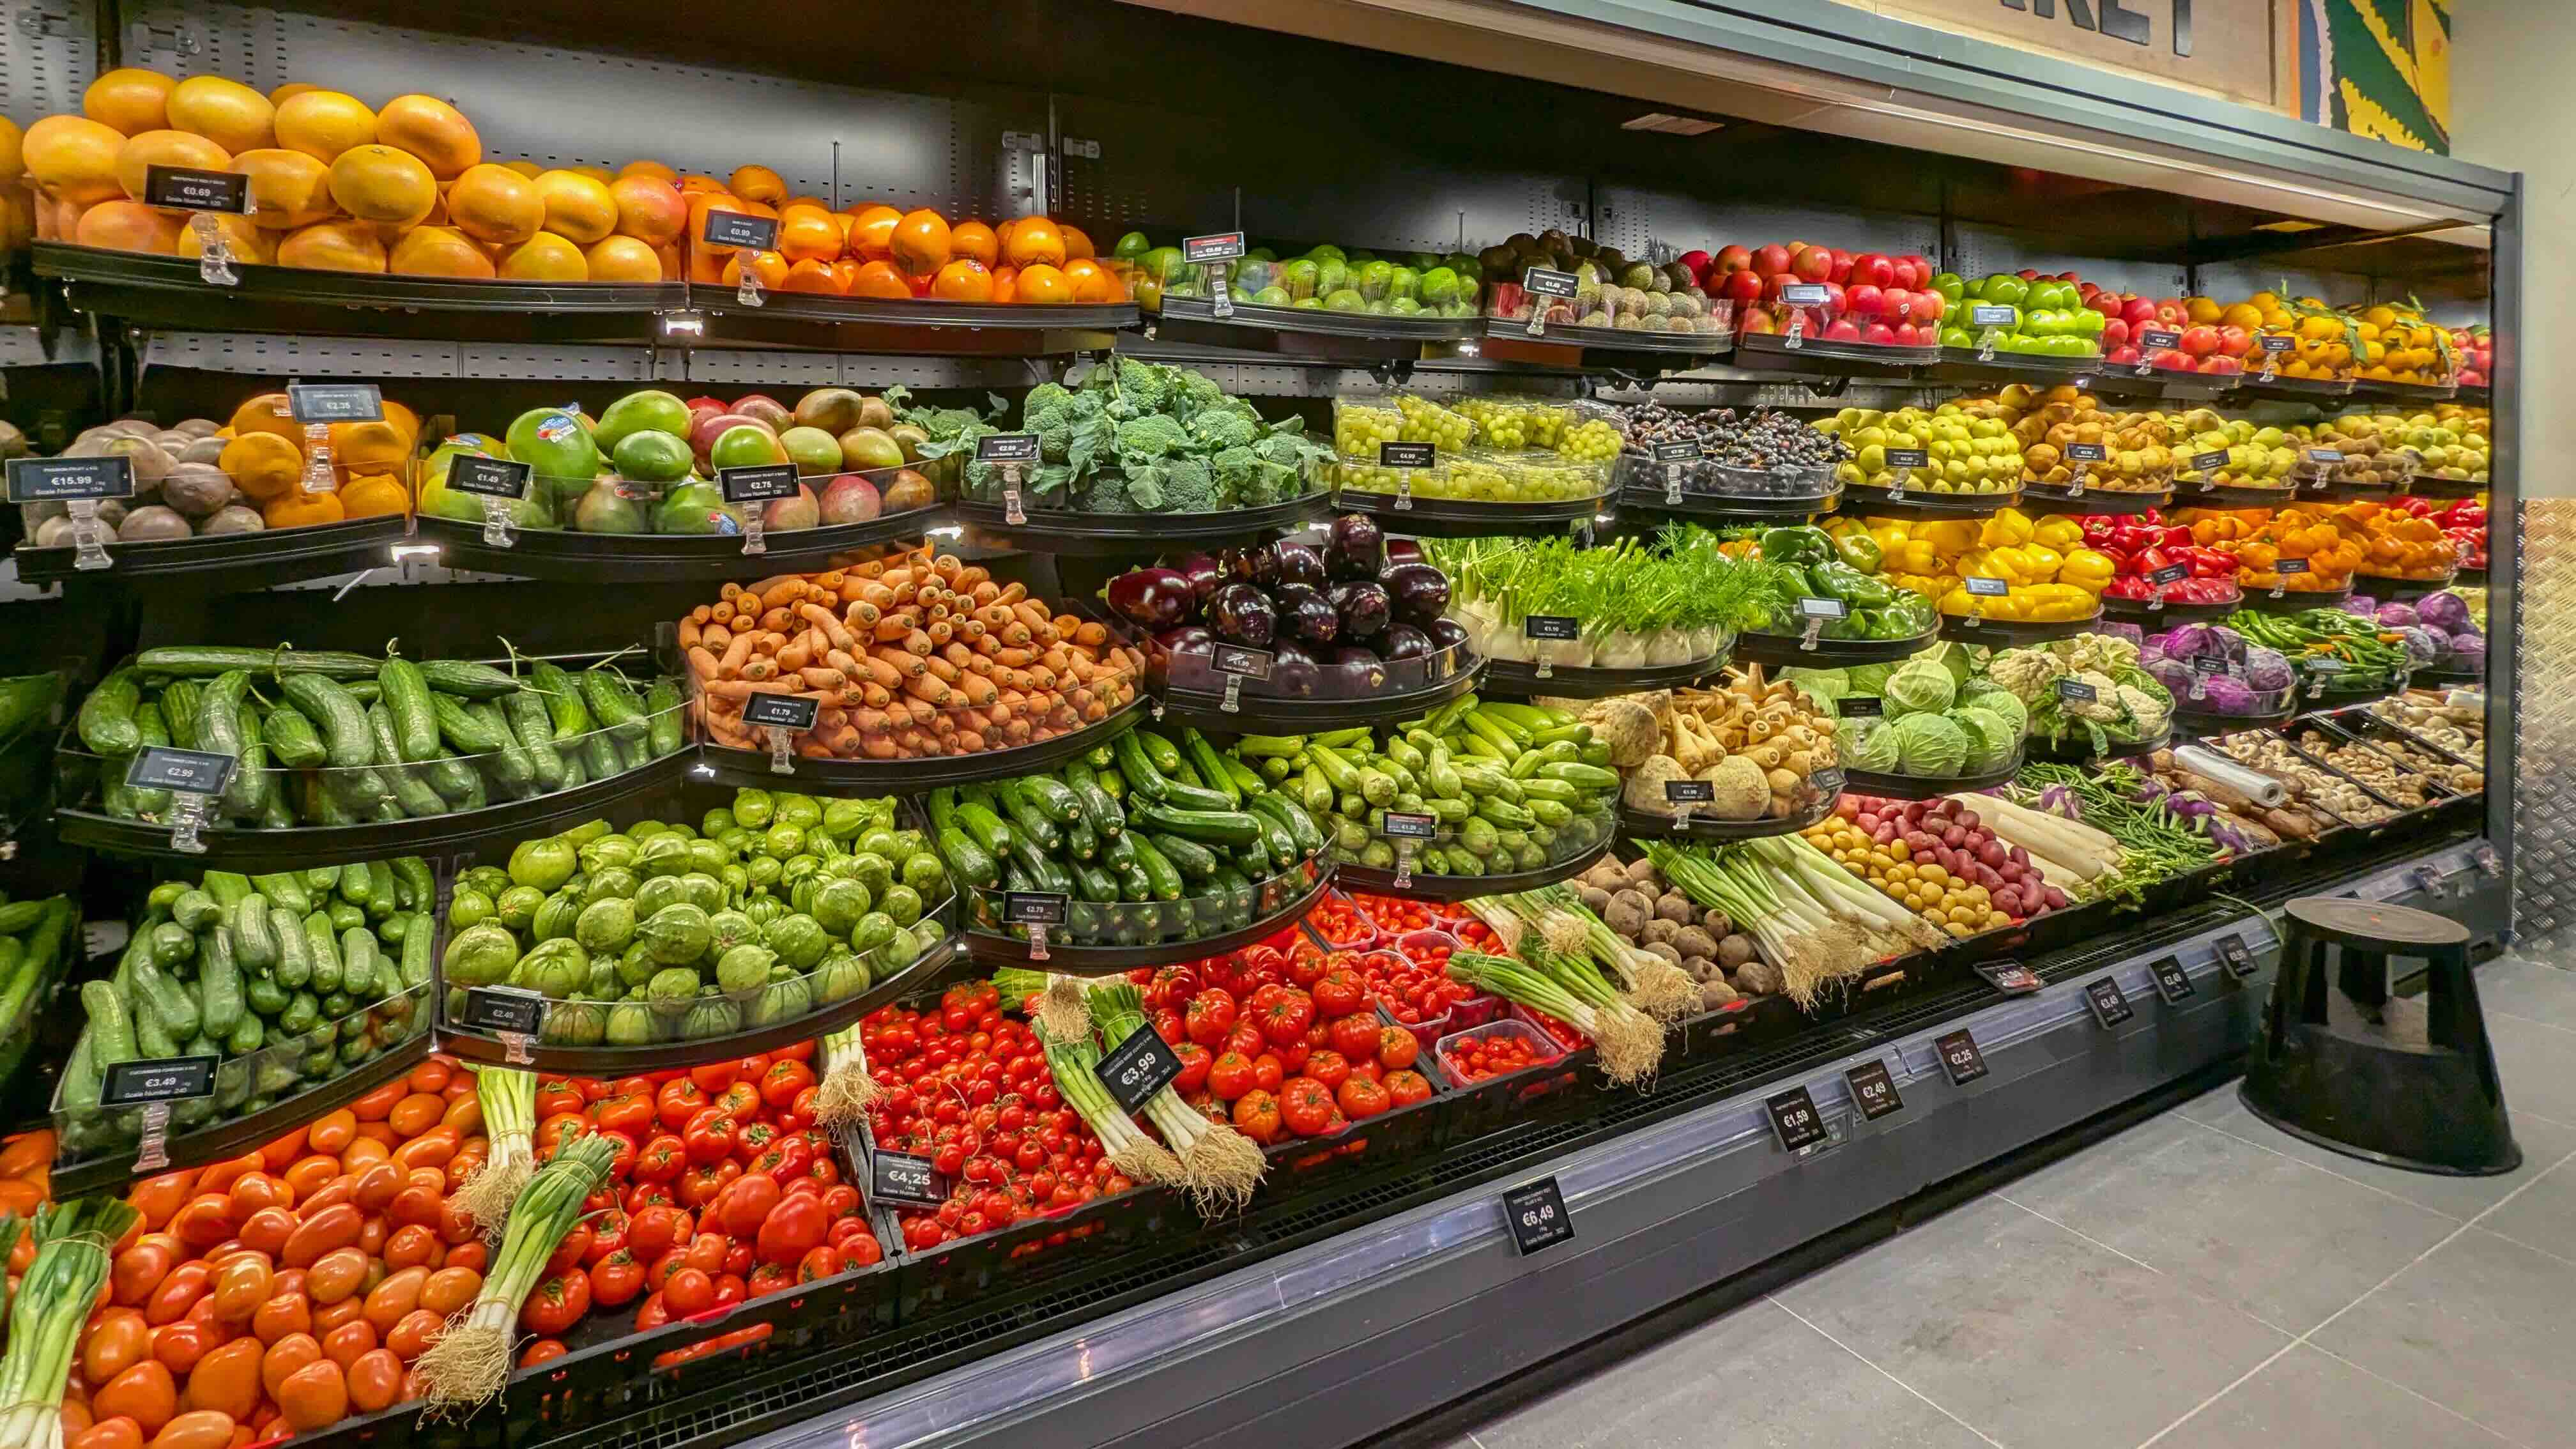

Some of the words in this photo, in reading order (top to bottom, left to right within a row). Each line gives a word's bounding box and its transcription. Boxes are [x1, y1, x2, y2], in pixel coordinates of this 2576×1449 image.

[183, 187, 211, 197] €0.69
[51, 476, 92, 486] €15.99
[477, 474, 499, 483] €1.49
[751, 481, 772, 489] €2.75
[771, 708, 790, 716] €1.79
[167, 767, 194, 778] €2.99
[1951, 1049, 1973, 1066] €2,25
[1121, 1052, 1156, 1087] €3,99
[145, 1077, 176, 1087] €3.49
[1862, 1081, 1886, 1099] €2,49
[1783, 1108, 1809, 1128] €1,59
[889, 1170, 930, 1186] €4,25
[1522, 1205, 1554, 1228] €6,49
